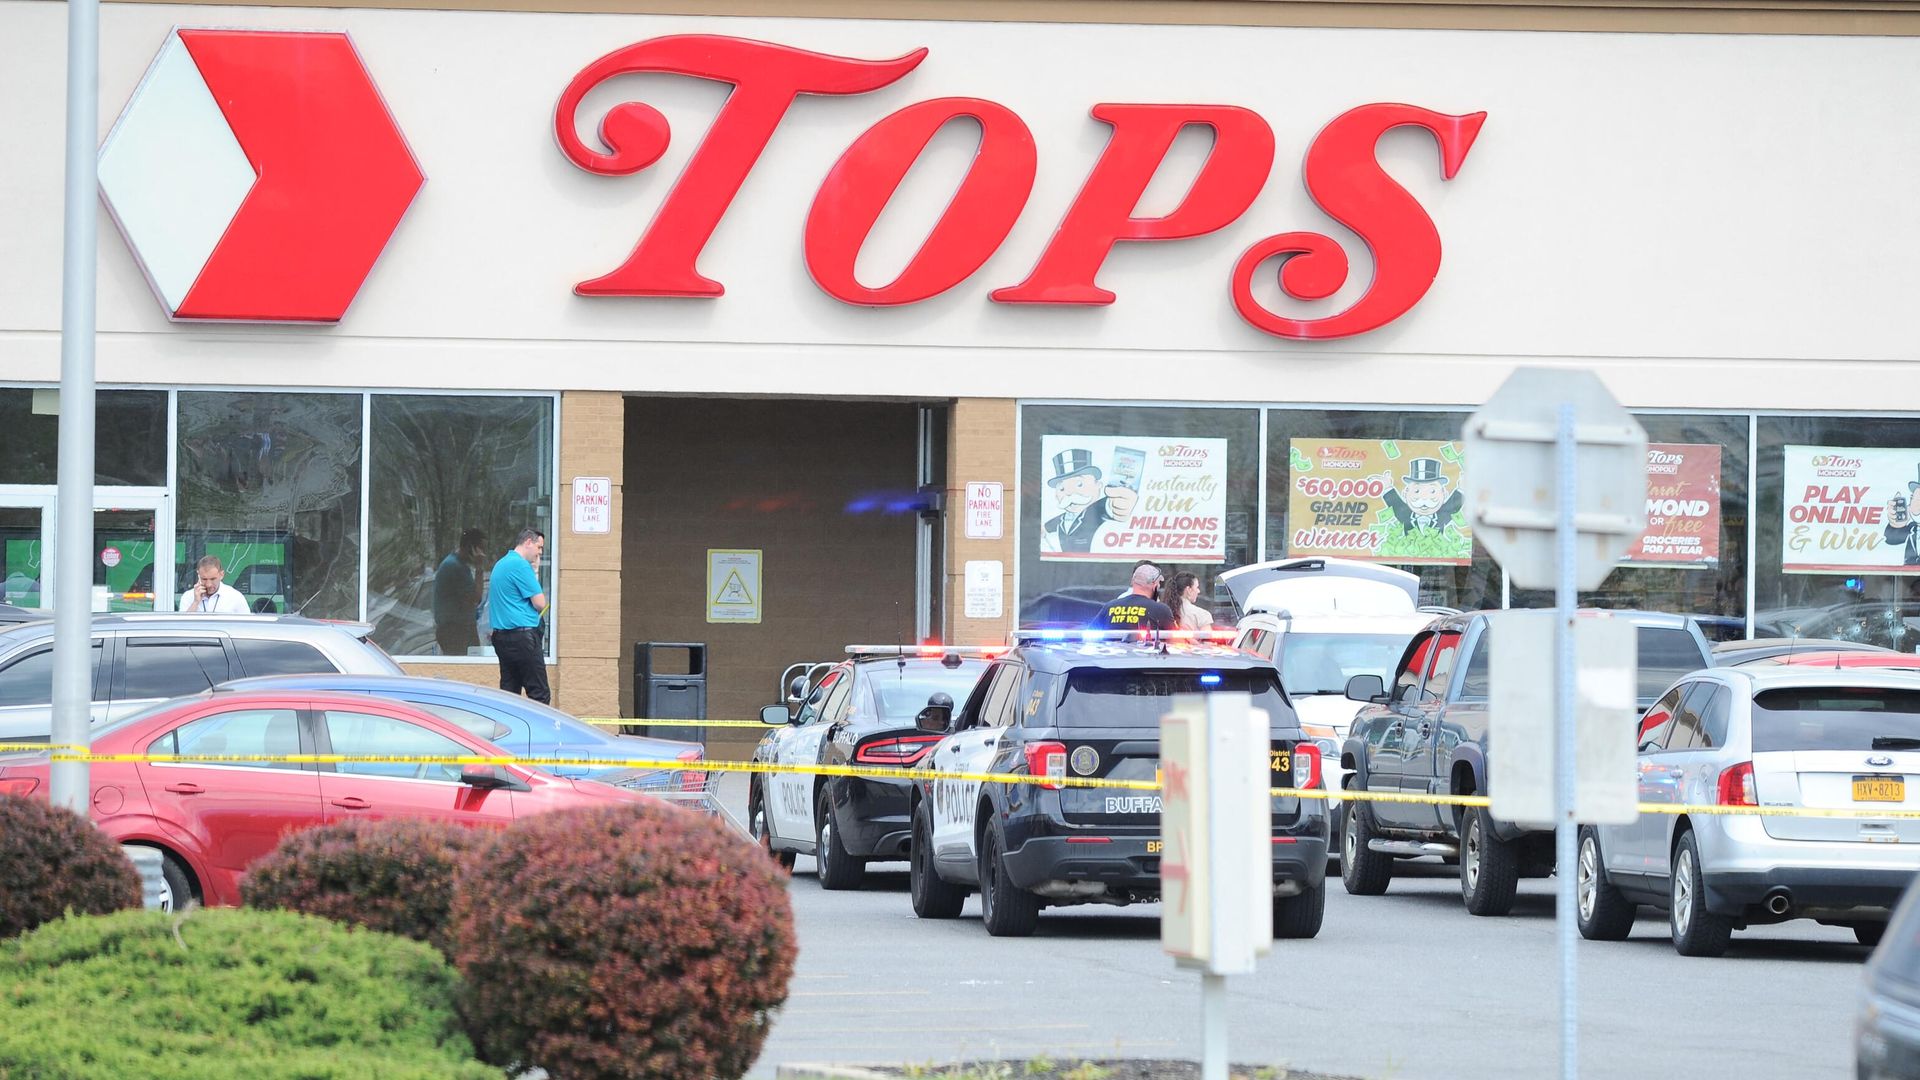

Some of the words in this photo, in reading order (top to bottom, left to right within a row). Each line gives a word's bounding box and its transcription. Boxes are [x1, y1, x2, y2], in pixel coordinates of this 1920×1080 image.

[585, 483, 599, 493] NO
[978, 487, 991, 498] NO
[1146, 474, 1218, 500] instantly
[1297, 477, 1384, 498] $60,000
[576, 494, 608, 505] PARKING
[1803, 485, 1870, 503] PLAY
[584, 506, 599, 514] FIRE
[968, 500, 1000, 510] PARKING
[1310, 500, 1368, 513] GRAND
[582, 514, 600, 522] LANE
[976, 511, 991, 519] FIRE
[1314, 513, 1363, 526] PRIZE
[1789, 505, 1884, 524] ONLINE
[975, 519, 993, 527] LANE
[1129, 516, 1218, 531] MILLIONS
[1650, 516, 1664, 525] OR
[1663, 515, 1704, 536] free
[1103, 532, 1134, 547] OF
[1136, 532, 1218, 549] PRIZES!
[1643, 536, 1701, 546] GROCERIES
[1642, 545, 1664, 554] FOR
[1664, 546, 1674, 554] A
[1675, 546, 1703, 555] YEAR
[1108, 606, 1146, 617] POLICE
[1111, 615, 1125, 623] ATF
[1126, 615, 1139, 623] K9
[833, 731, 859, 746] BUFFALO
[1268, 756, 1290, 772] 43
[782, 782, 808, 816] POLICE
[945, 783, 975, 824] POLICE
[1105, 797, 1164, 814] BUFFA
[1147, 841, 1164, 853] BP
